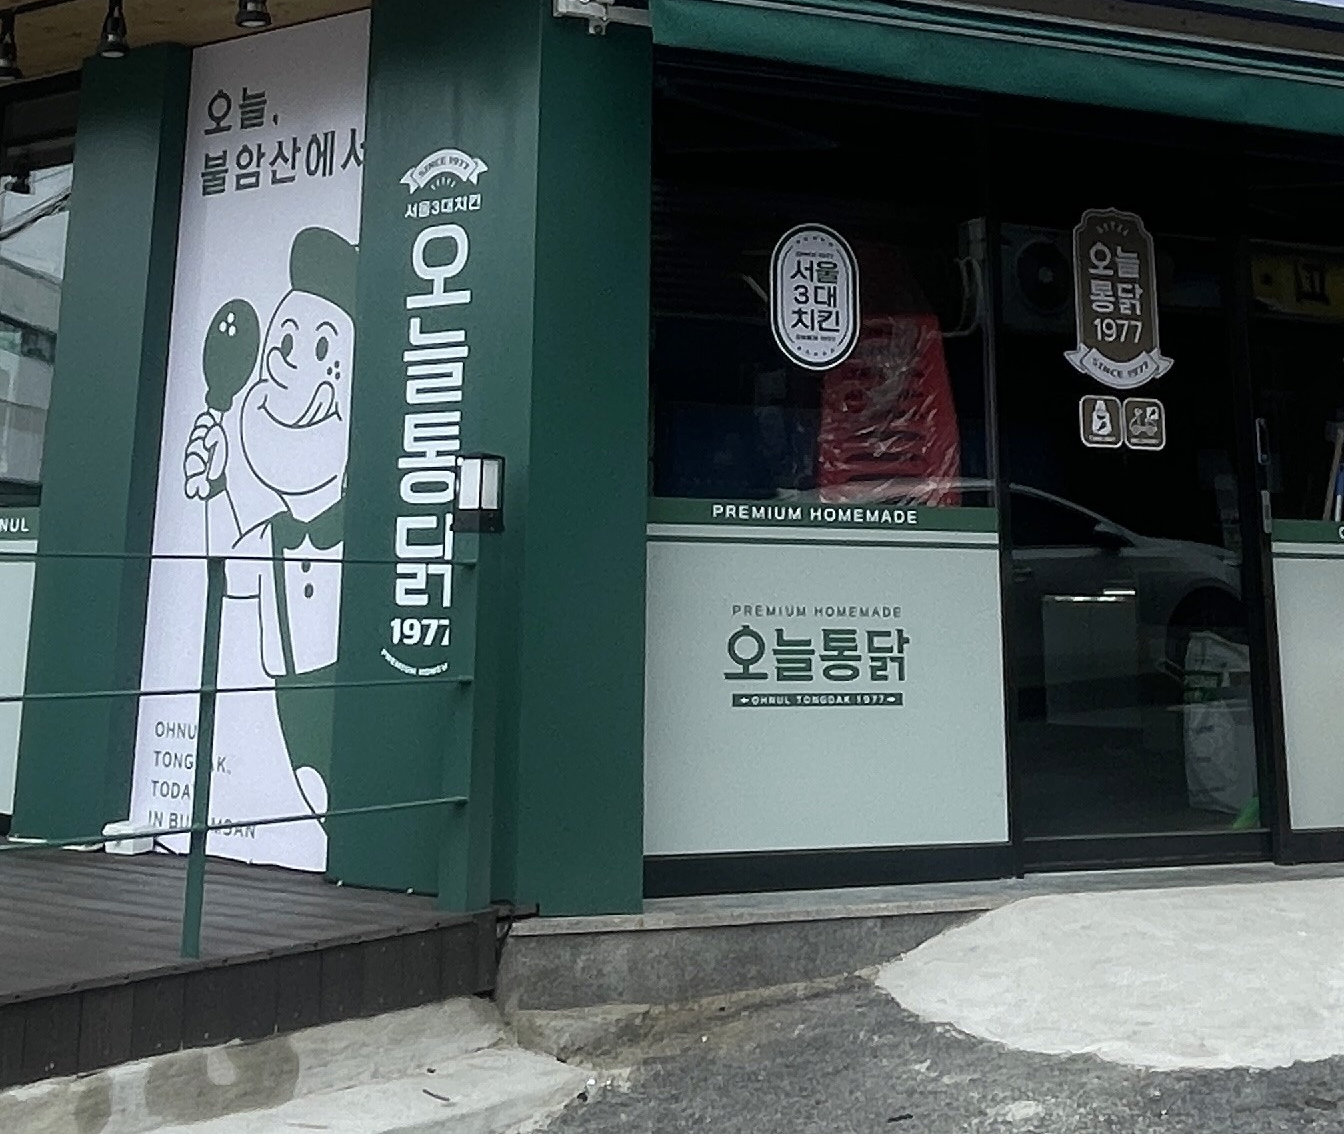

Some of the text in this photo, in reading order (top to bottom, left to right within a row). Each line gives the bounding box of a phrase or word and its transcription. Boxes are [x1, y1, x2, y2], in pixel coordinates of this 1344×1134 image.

[790, 260, 839, 284] 서울
[1088, 241, 1141, 279] 오늘
[793, 284, 837, 308] 3대
[1090, 279, 1143, 316] 통닭
[790, 308, 840, 333] 치킨
[1094, 318, 1143, 344] 1977
[395, 224, 471, 608] 오늘통닭
[712, 504, 918, 524] PREMIUM HOMEMADE
[732, 604, 902, 618] PREMIUM HOMEMADE
[390, 618, 449, 646] 1977
[724, 625, 910, 681] 오늘통닭
[154, 721, 197, 740] OHNU
[150, 779, 192, 800] TODA
[148, 810, 164, 828] IN
